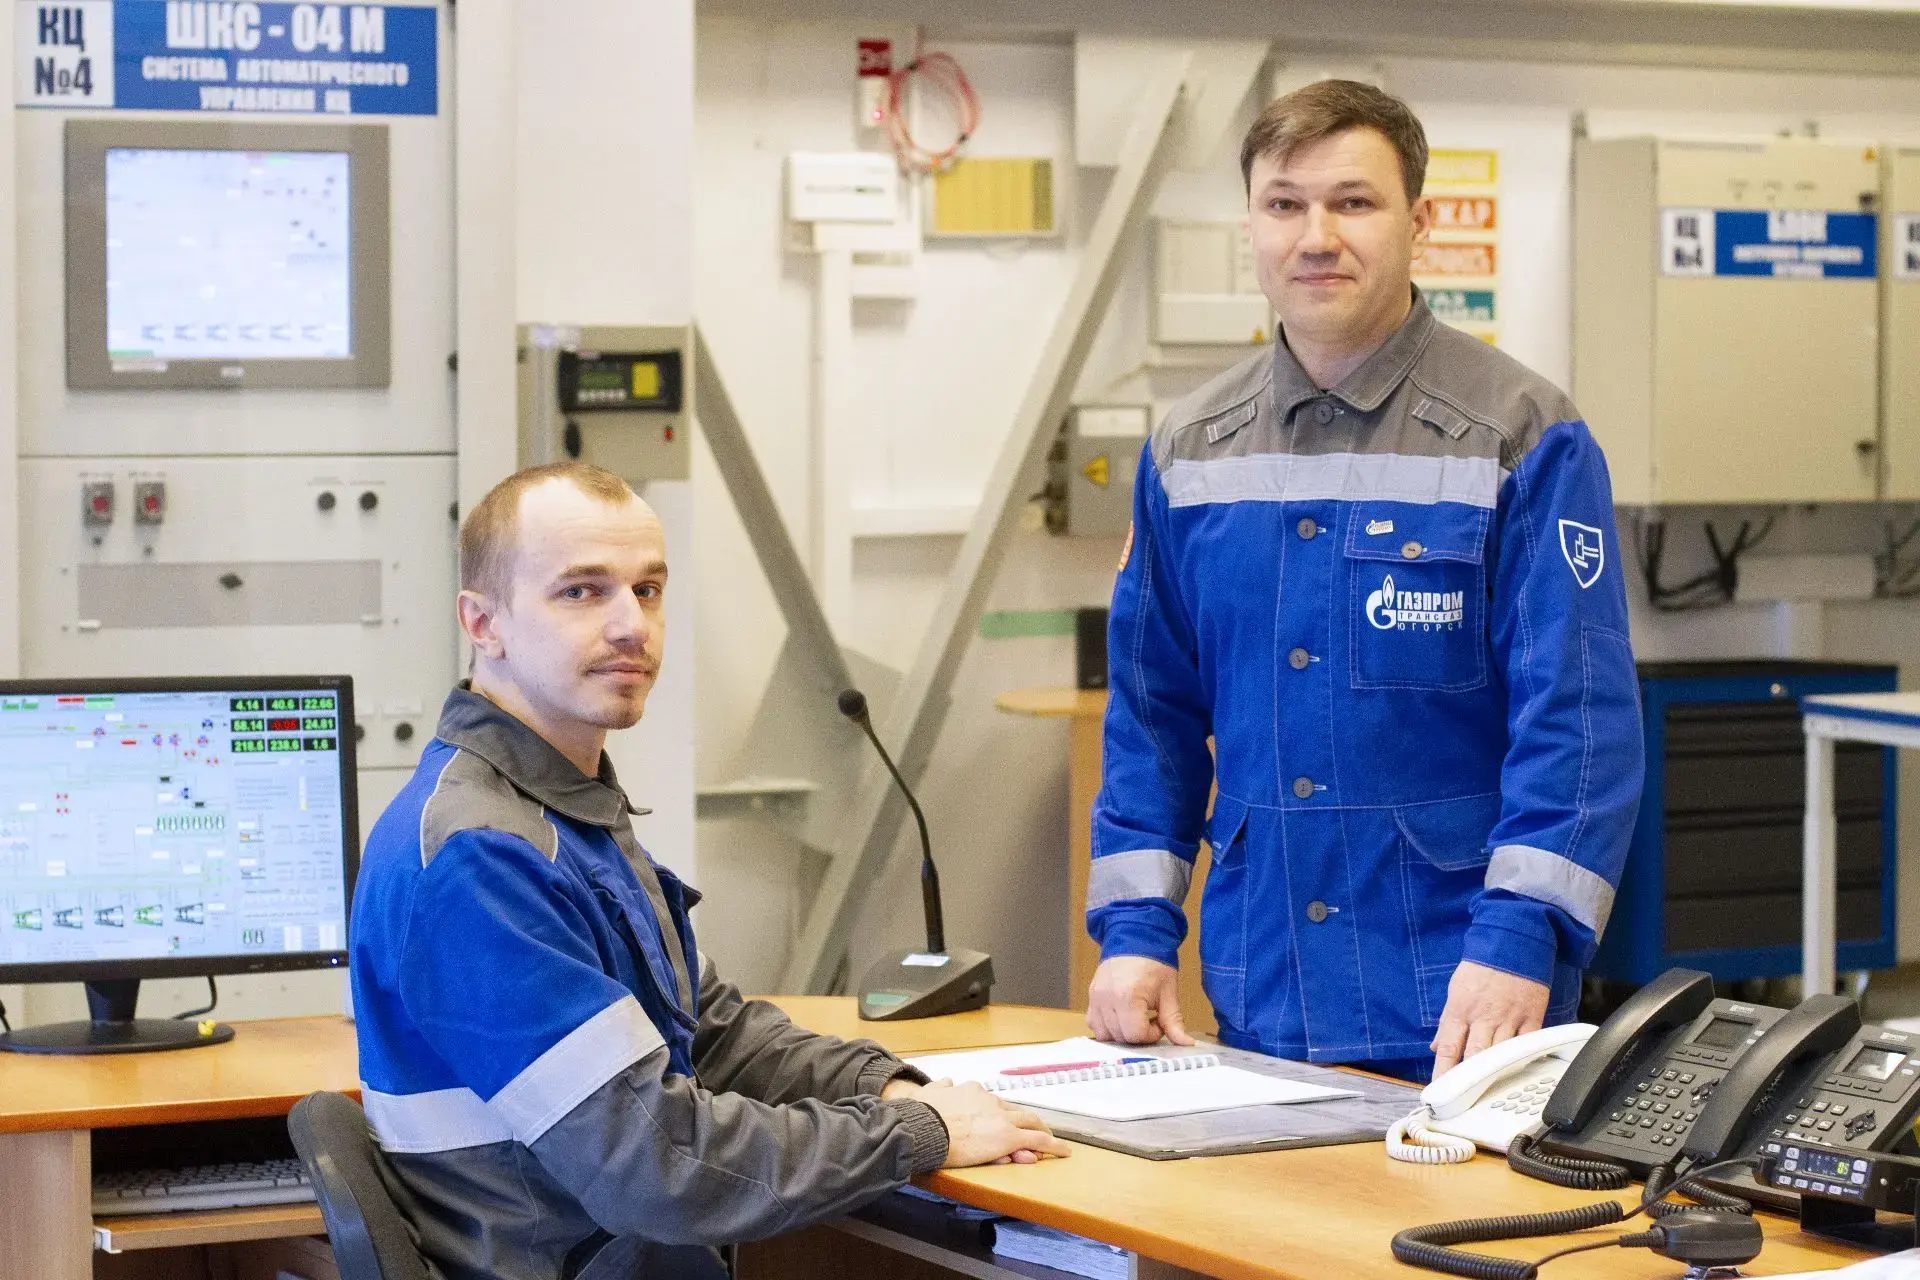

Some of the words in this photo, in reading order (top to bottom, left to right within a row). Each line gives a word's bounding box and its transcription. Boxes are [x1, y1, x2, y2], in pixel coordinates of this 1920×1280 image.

[38, 7, 85, 53] КЦ
[166, 2, 261, 50] ШКС
[292, 5, 343, 52] 04
[350, 7, 385, 53] М
[34, 57, 93, 96] №4
[142, 57, 228, 81] СИСТЕМА
[1396, 591, 1464, 612] ГАЗПРОМ
